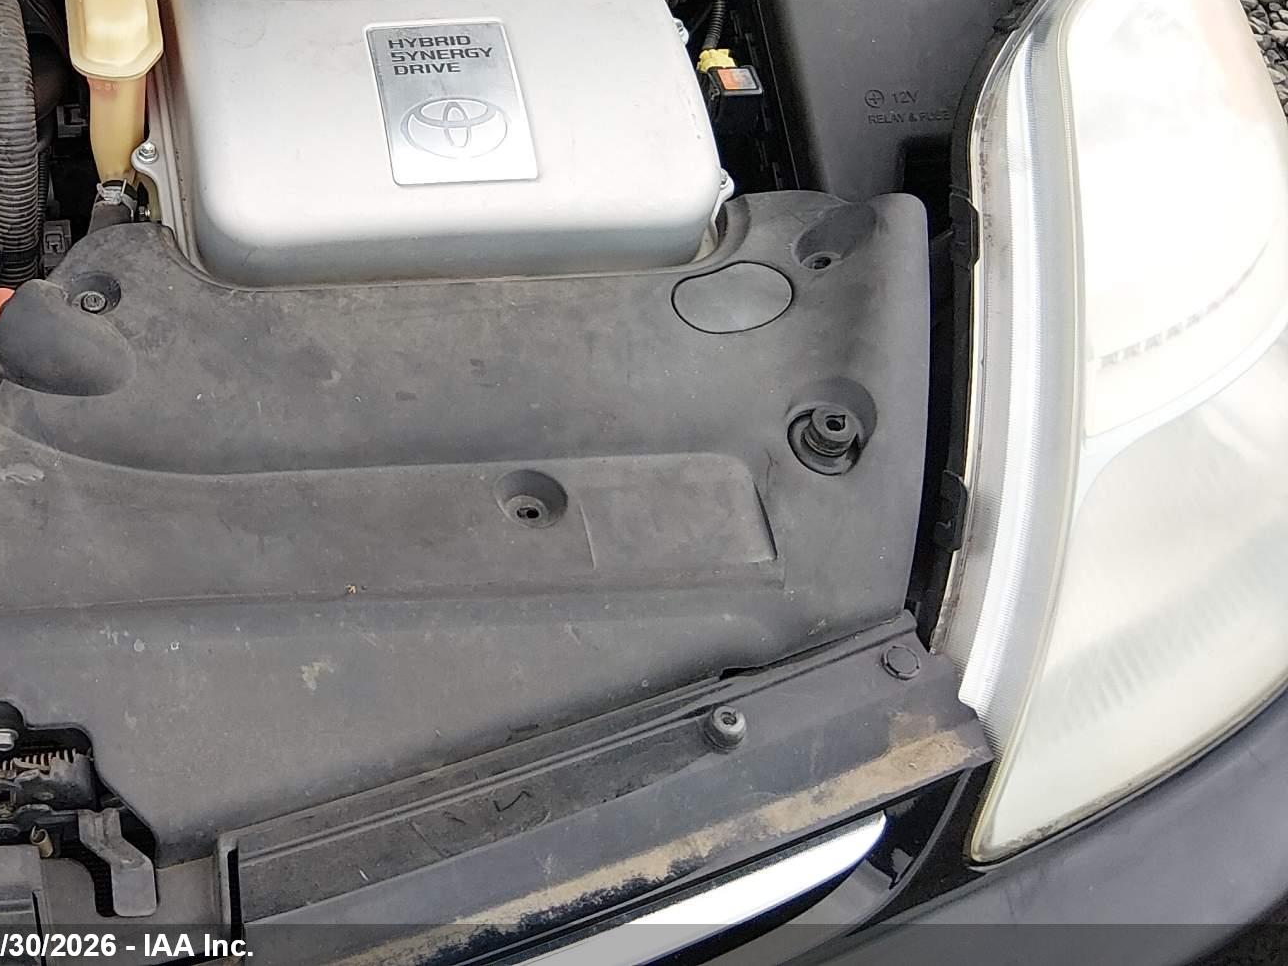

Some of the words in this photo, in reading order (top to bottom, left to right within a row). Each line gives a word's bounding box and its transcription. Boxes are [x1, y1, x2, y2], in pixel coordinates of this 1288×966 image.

[387, 35, 472, 50] HYBRID
[390, 47, 494, 63] SYNERGY
[393, 62, 462, 76] DRIVE
[891, 89, 920, 104] 12V
[868, 112, 906, 125] RELAY
